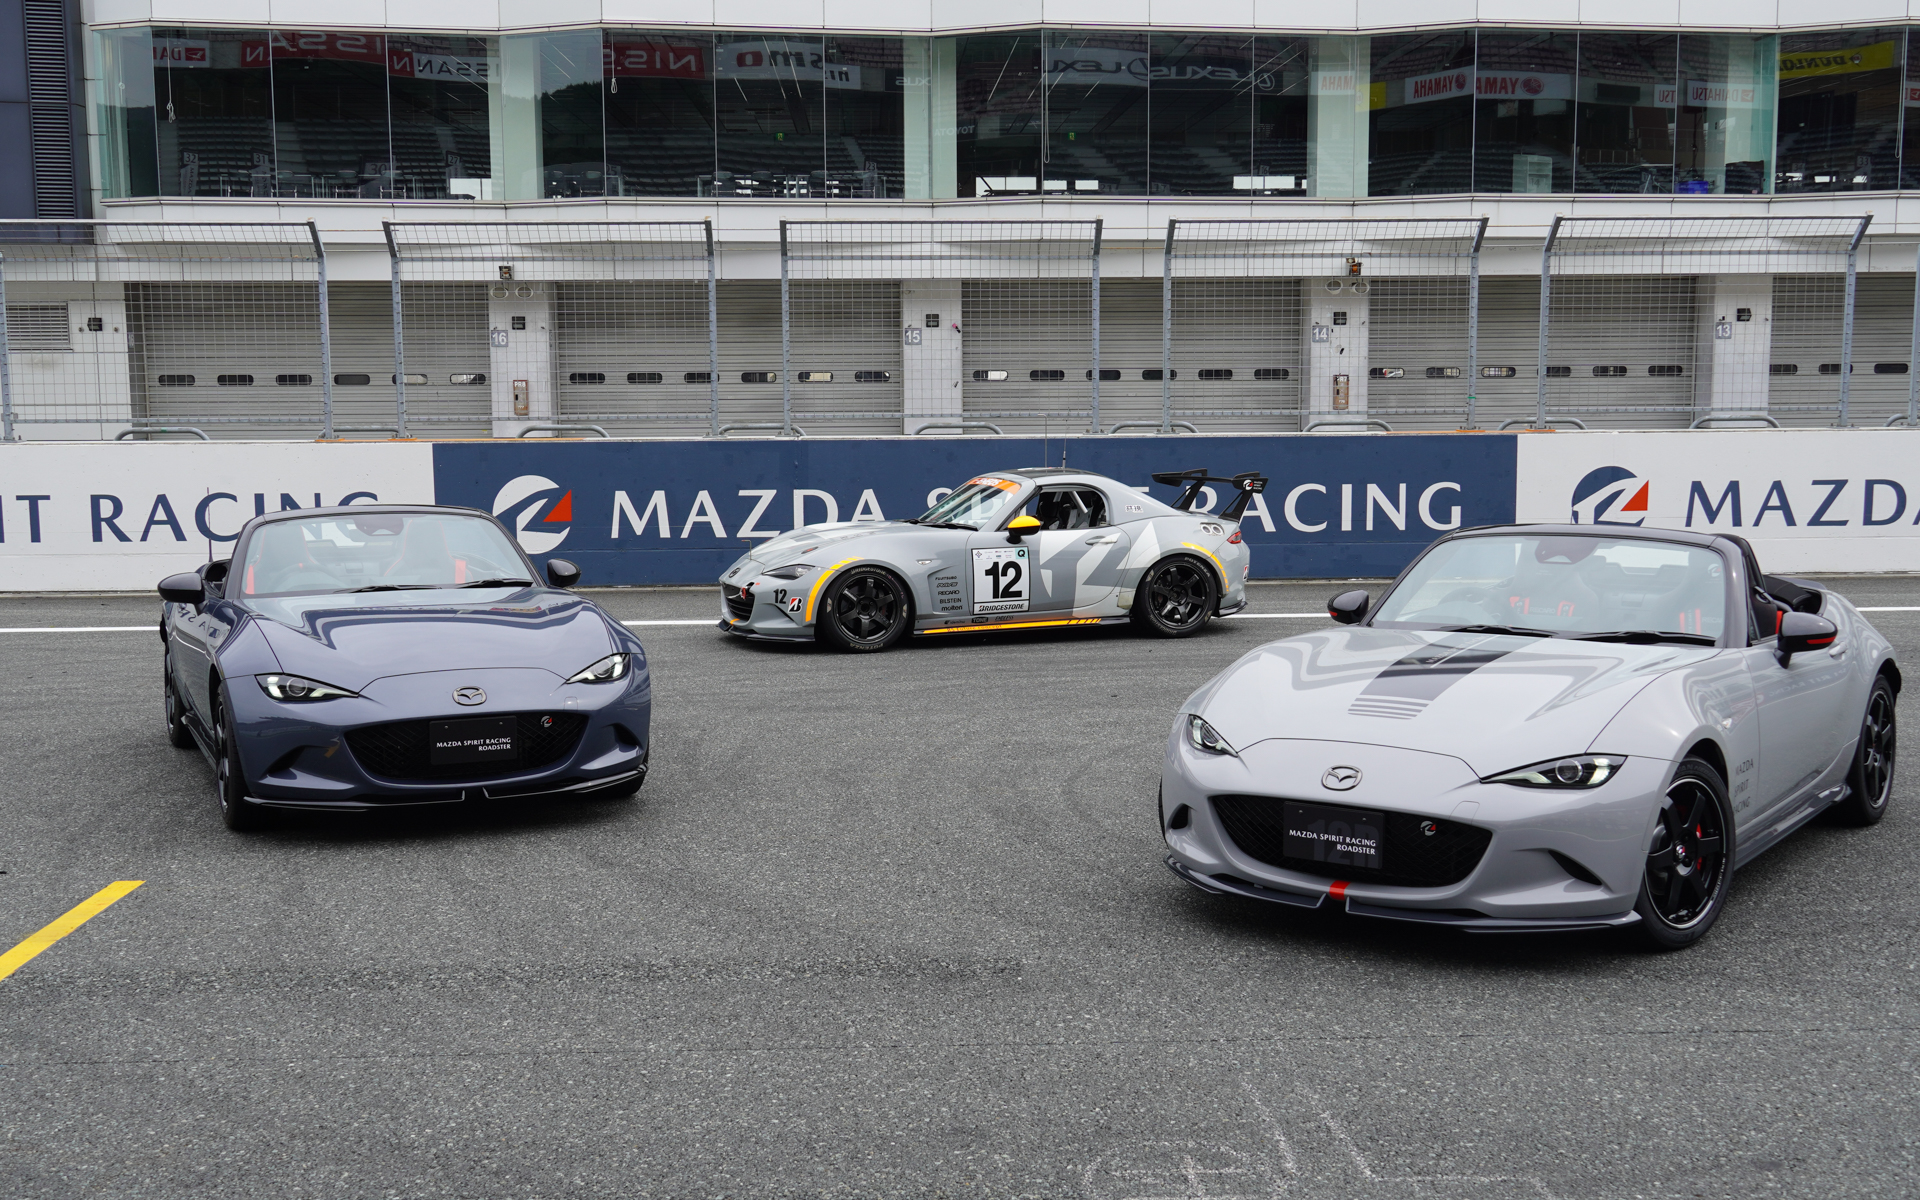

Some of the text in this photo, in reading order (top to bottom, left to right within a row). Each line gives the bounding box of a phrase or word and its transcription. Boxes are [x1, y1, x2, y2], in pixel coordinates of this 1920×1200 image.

[185, 154, 196, 164] 32
[255, 154, 266, 164] 31
[906, 330, 920, 343] 15
[1313, 327, 1327, 340] 14
[1716, 324, 1731, 337] 13
[492, 332, 507, 345] 16
[1685, 479, 1920, 528] MAZD
[611, 489, 885, 539] MAZDA
[1185, 482, 1462, 532] RACING
[1017, 549, 1026, 558] Q
[1184, 556, 1211, 578] POTENZA
[985, 561, 1022, 600] 12
[773, 588, 787, 604] 12
[978, 603, 1025, 612] BRIDGESTONE
[478, 743, 511, 752] ROADSTER
[1289, 830, 1376, 847] MAZDA SPIRIT RACING
[1336, 844, 1376, 855] ROADSTER
